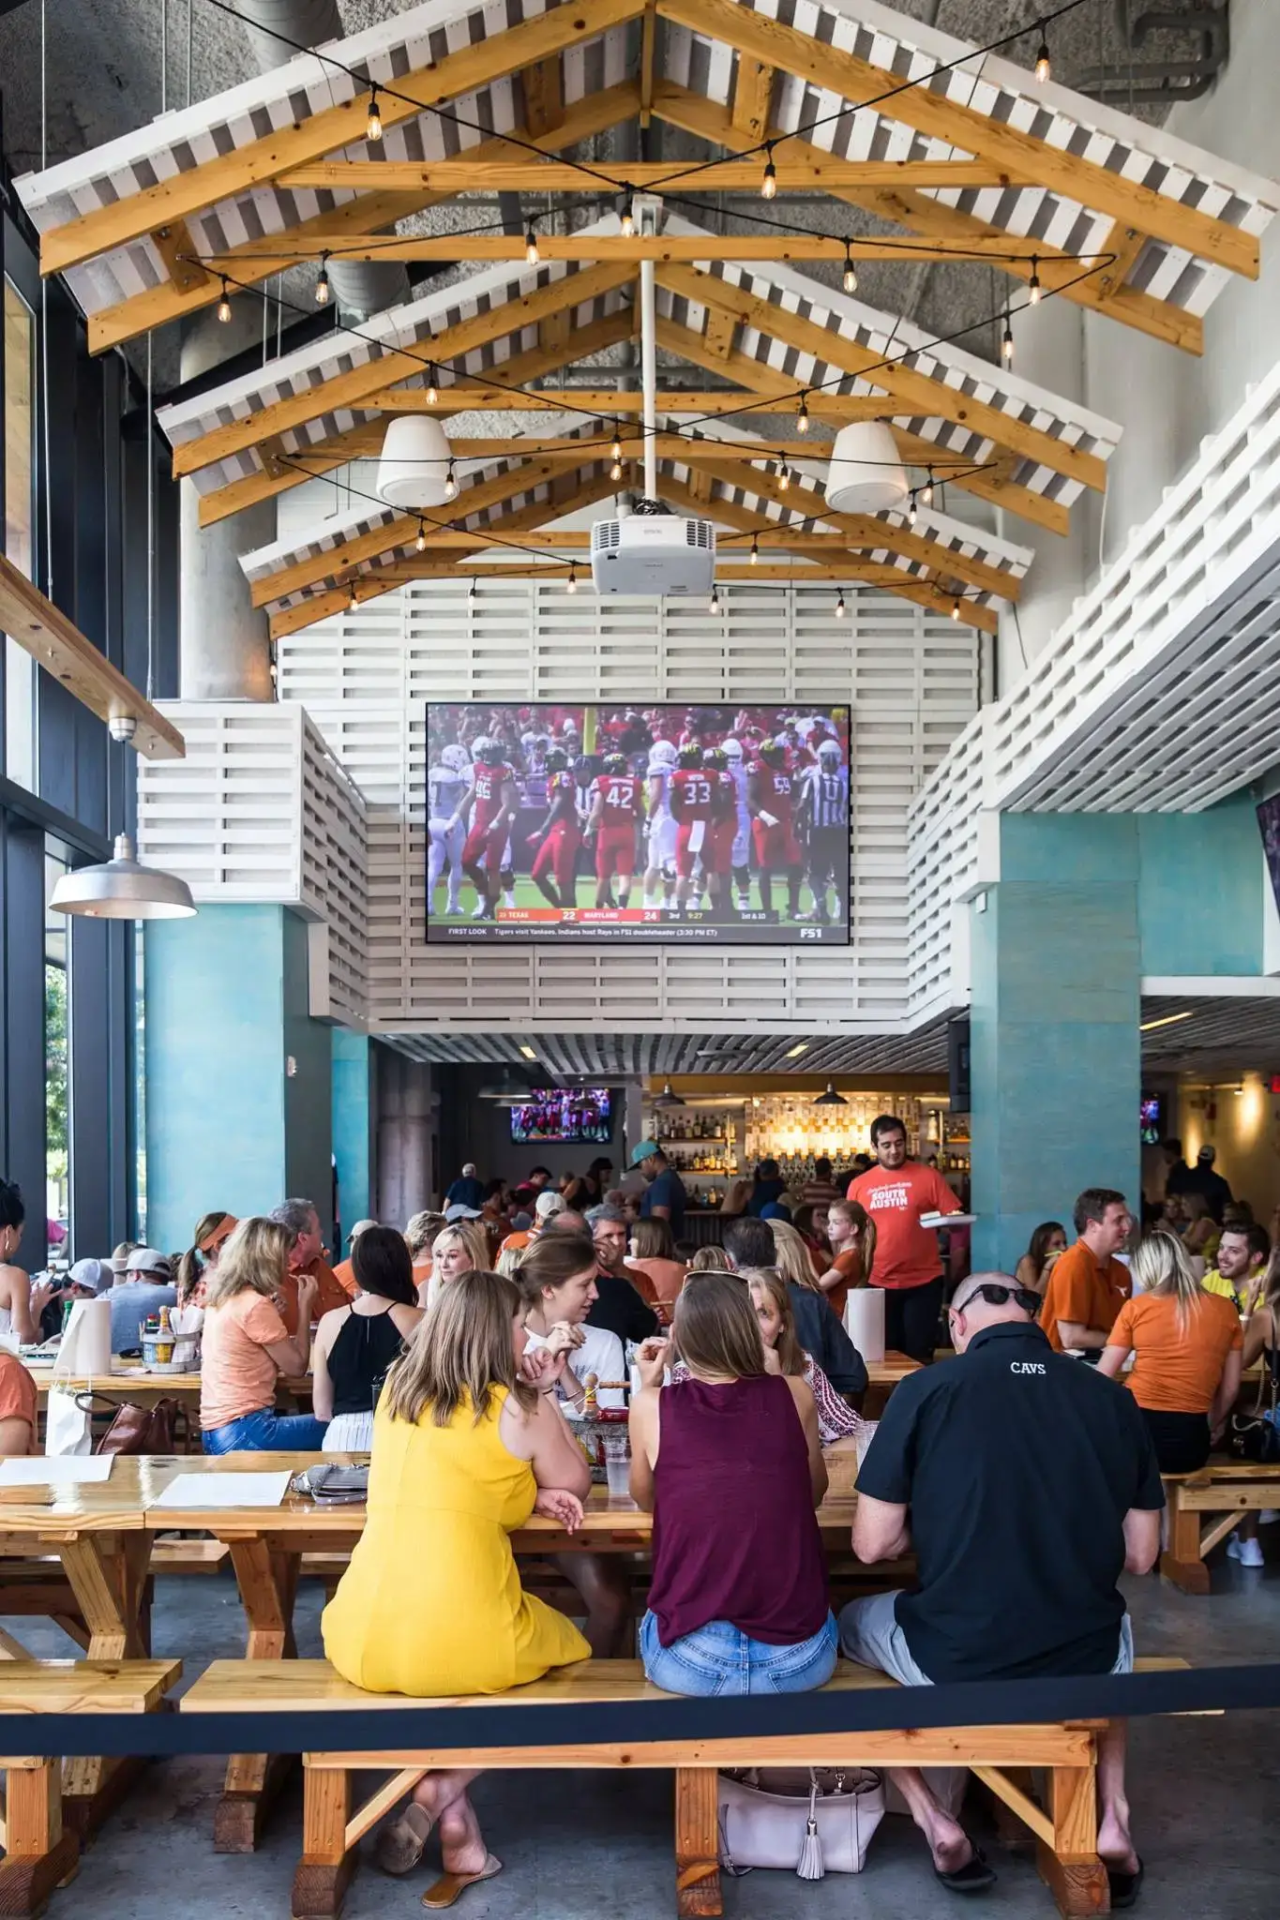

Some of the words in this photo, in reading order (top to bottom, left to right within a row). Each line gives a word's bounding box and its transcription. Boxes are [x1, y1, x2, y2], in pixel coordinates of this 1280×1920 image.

[606, 786, 633, 808] 42
[684, 782, 710, 804] 33
[562, 911, 576, 920] 22
[644, 911, 657, 920] 24
[669, 912, 680, 920] 3rd
[495, 928, 514, 936] Tigers
[558, 928, 581, 936] Indians
[582, 928, 596, 936] host
[597, 928, 612, 936] Rays
[633, 928, 675, 936] doubleheader
[800, 928, 822, 938] FS1
[872, 1188, 906, 1200] SOUTH
[870, 1196, 908, 1210] AUSTIN
[1010, 1361, 1047, 1374] CAVS
